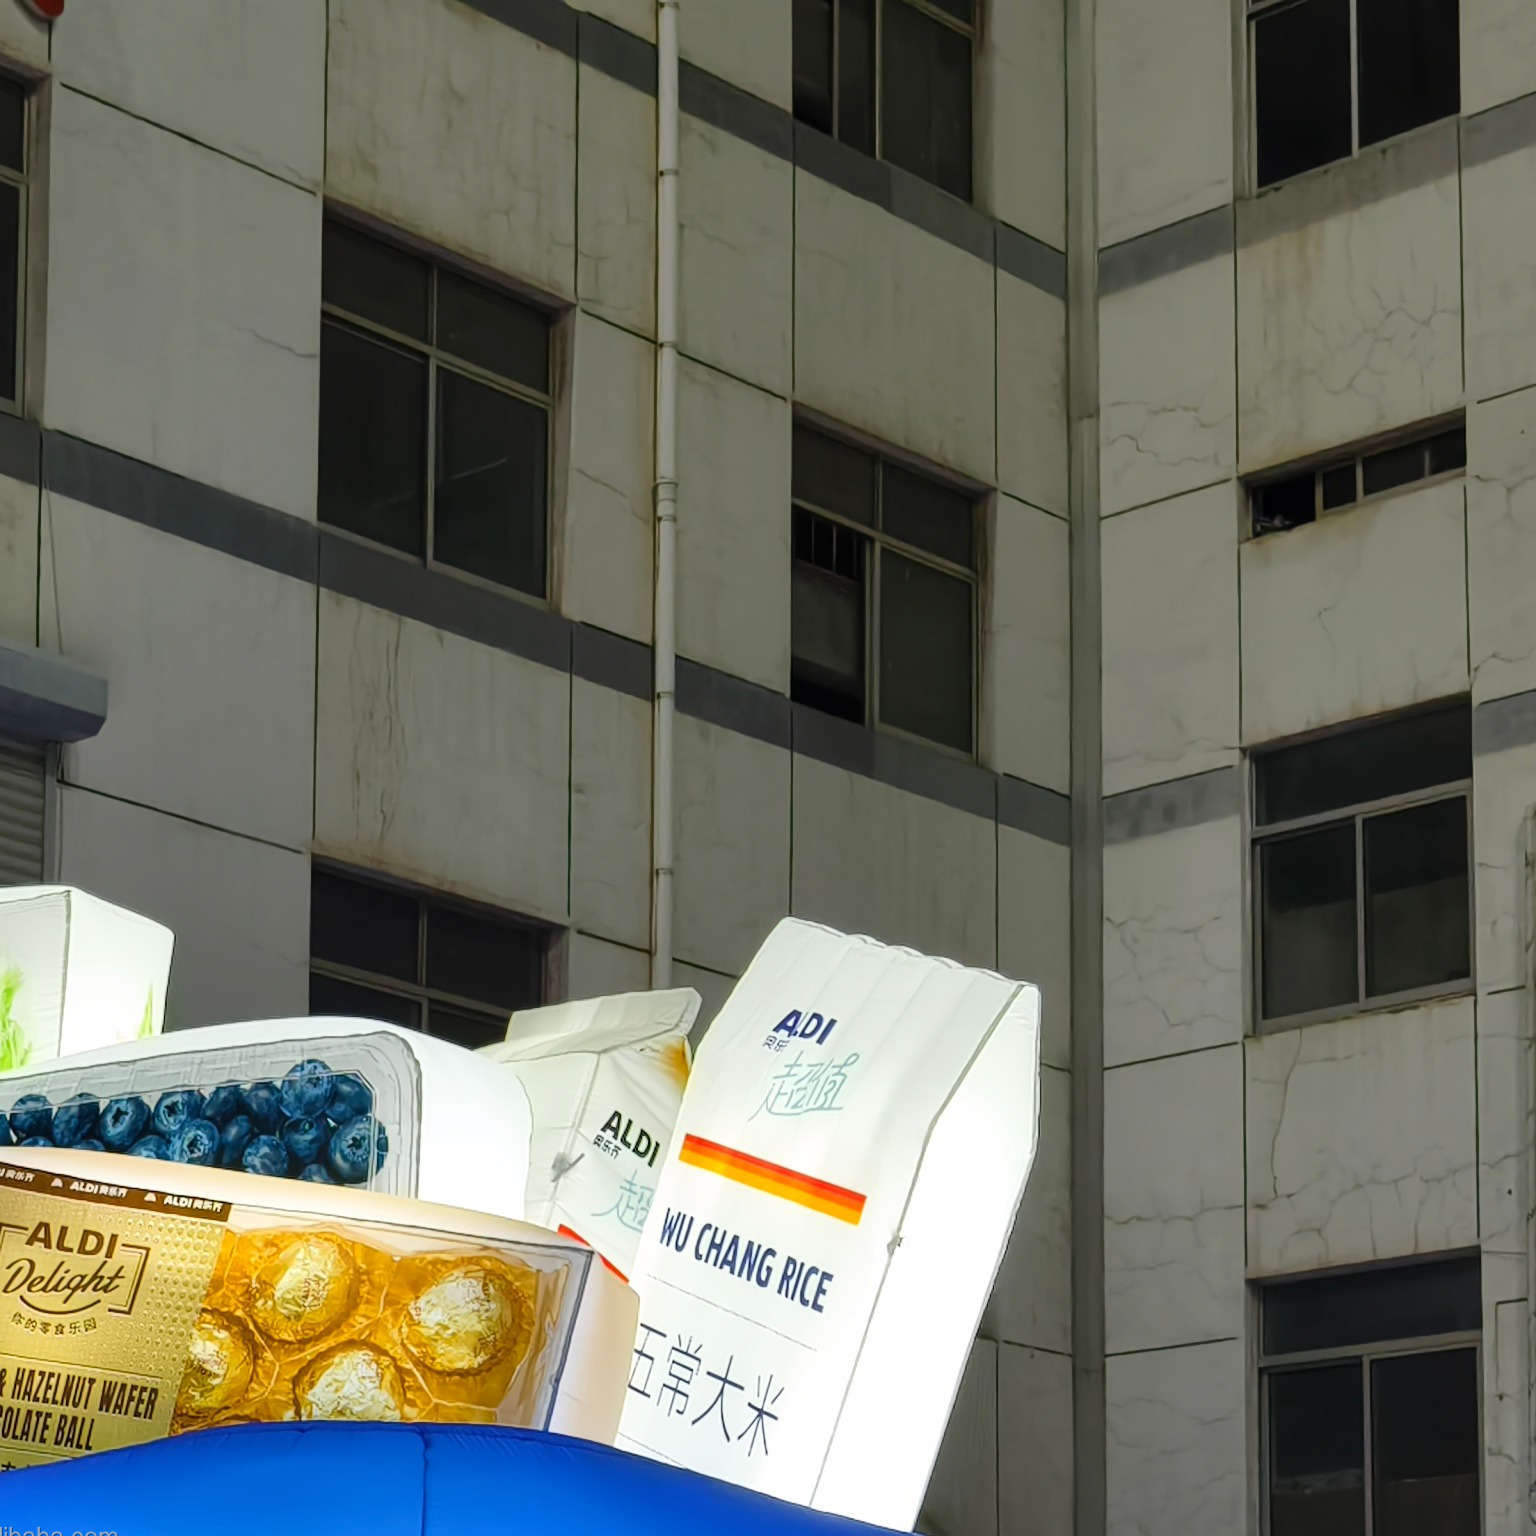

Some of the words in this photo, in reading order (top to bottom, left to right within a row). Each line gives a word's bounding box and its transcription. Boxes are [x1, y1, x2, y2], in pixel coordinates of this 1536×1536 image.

[601, 1110, 661, 1168] ALDI
[70, 1181, 98, 1194] ALDI
[164, 1195, 193, 1208] ALDI
[25, 1221, 119, 1259] ALDI
[659, 1208, 695, 1253] WU
[694, 1223, 777, 1288] CHANG
[777, 1256, 834, 1313] RICE
[2, 1258, 126, 1304] Delight
[11, 1367, 97, 1411] HAZELNUT
[98, 1380, 159, 1420] WAFER
[627, 1322, 785, 1457] 五常大米
[54, 1413, 96, 1451] BALL
